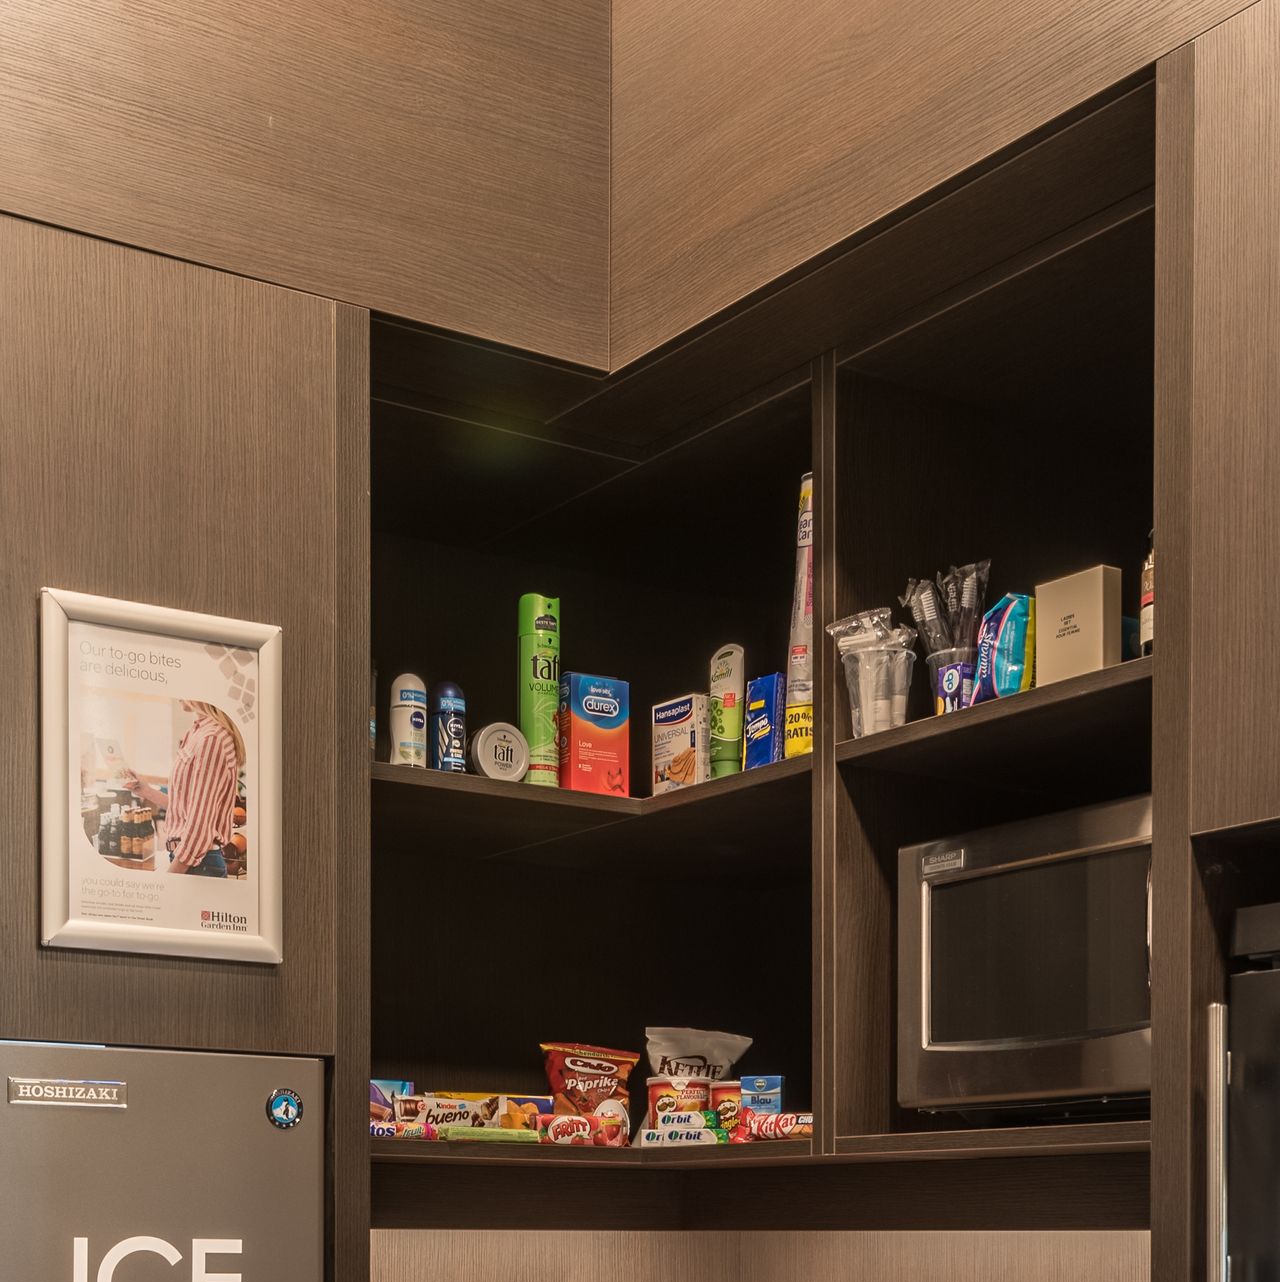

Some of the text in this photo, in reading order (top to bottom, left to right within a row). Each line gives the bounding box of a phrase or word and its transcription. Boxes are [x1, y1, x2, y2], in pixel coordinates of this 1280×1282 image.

[79, 640, 182, 669] Our to-go bites
[79, 661, 168, 684] are delicious,
[586, 700, 615, 713] durex
[656, 703, 691, 720] Hansaplast
[746, 714, 769, 738] Tempo
[786, 727, 813, 739] RATIS
[654, 727, 688, 743] UNIVERSAL
[579, 740, 592, 748] Love
[494, 745, 513, 763] taft
[929, 852, 957, 864] SHARP
[100, 878, 124, 888] could
[126, 881, 141, 891] say
[81, 887, 97, 896] the
[136, 890, 160, 902] to-go
[211, 911, 247, 924] Hilton
[201, 921, 247, 932] Garden Inn
[566, 1076, 618, 1092] Paprika
[18, 1084, 118, 1100] HOSHIZAKI
[750, 1096, 772, 1105] Blau
[425, 1109, 469, 1125] bueno
[662, 1114, 692, 1125] Orbit
[370, 1123, 395, 1137] tos
[750, 1113, 796, 1139] KitKat
[668, 1130, 702, 1141] Orbit
